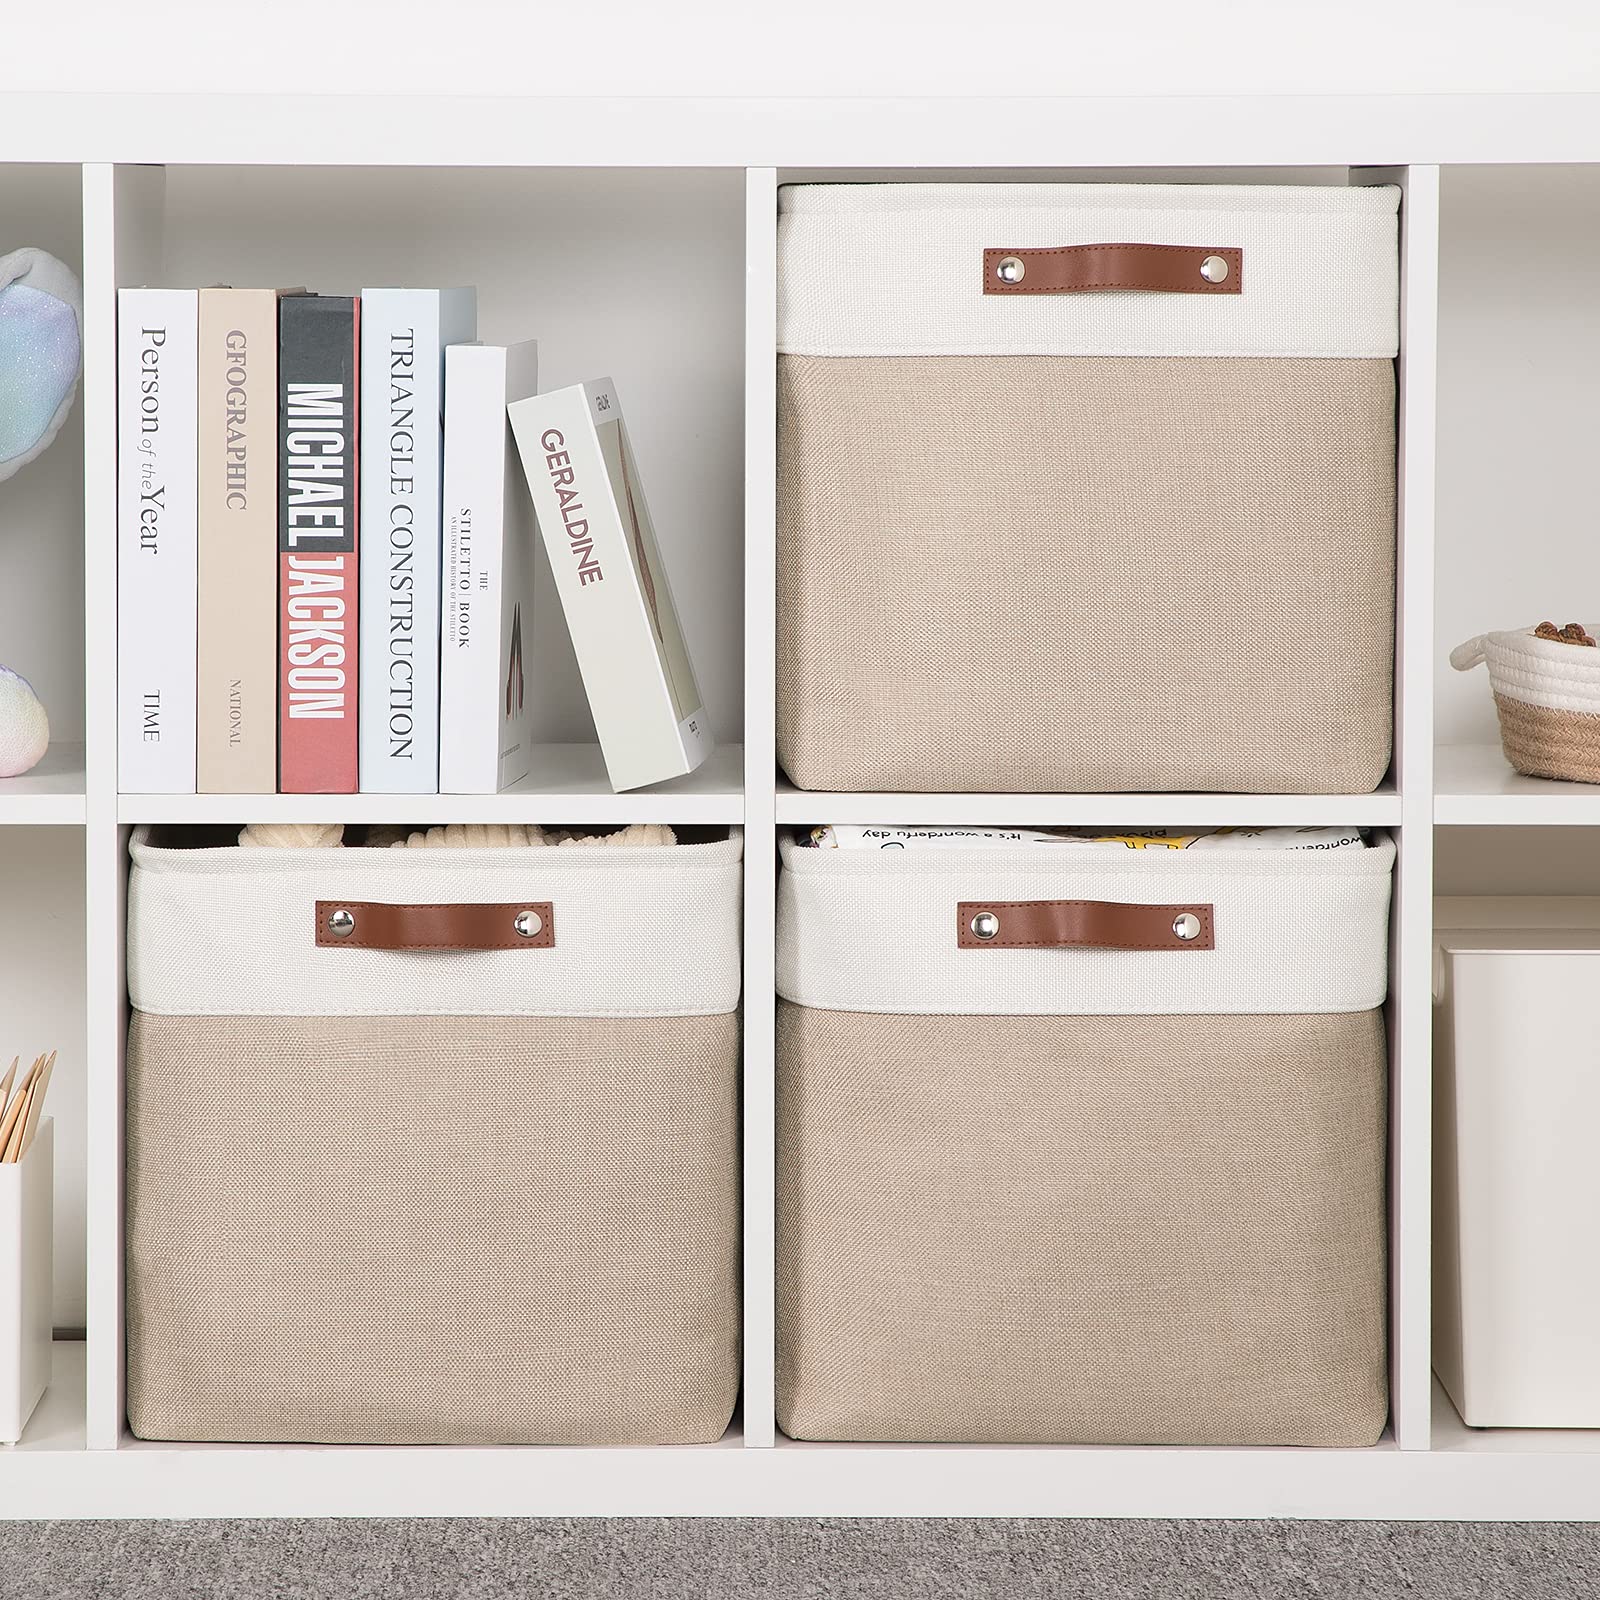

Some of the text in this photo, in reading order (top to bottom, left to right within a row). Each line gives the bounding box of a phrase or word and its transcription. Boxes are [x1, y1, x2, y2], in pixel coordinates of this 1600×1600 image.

[141, 326, 166, 434] Person
[137, 438, 156, 457] of
[140, 485, 165, 555] Year
[541, 428, 603, 586] GERALDINE
[287, 383, 346, 719] MICHAEL JACKSON
[390, 328, 414, 760] TRIANGLE CONSTRUCTION
[459, 508, 471, 648] STILETTO BOOK
[479, 570, 488, 590] THE
[143, 689, 160, 742] TIME
[229, 679, 242, 748] NATIONAL
[862, 829, 890, 839] day
[999, 831, 1021, 840] It's
